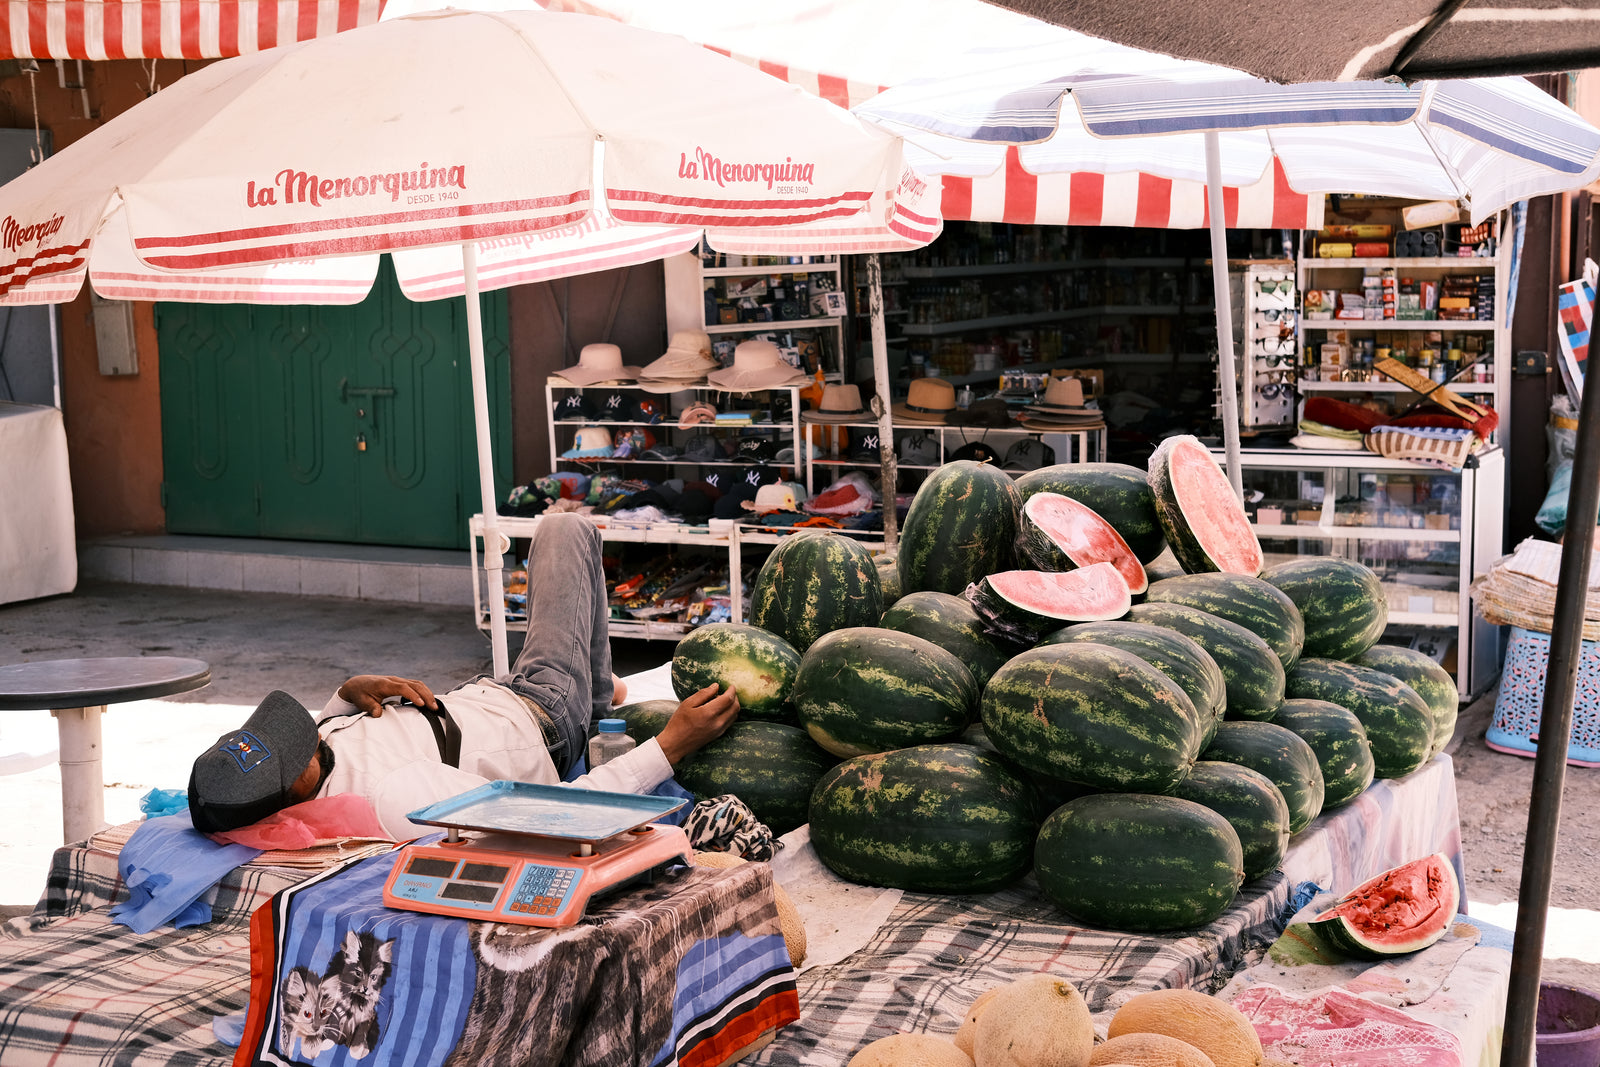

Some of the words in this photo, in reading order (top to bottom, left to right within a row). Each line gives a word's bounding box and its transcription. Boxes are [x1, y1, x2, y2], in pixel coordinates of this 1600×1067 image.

[678, 152, 699, 180] la
[695, 145, 815, 190] Menorquina
[246, 180, 277, 208] la
[274, 161, 467, 208] Menorquina
[407, 194, 435, 205] DESDE
[438, 191, 459, 202] 1940
[776, 186, 794, 195] DESDE
[795, 185, 809, 194] 1940
